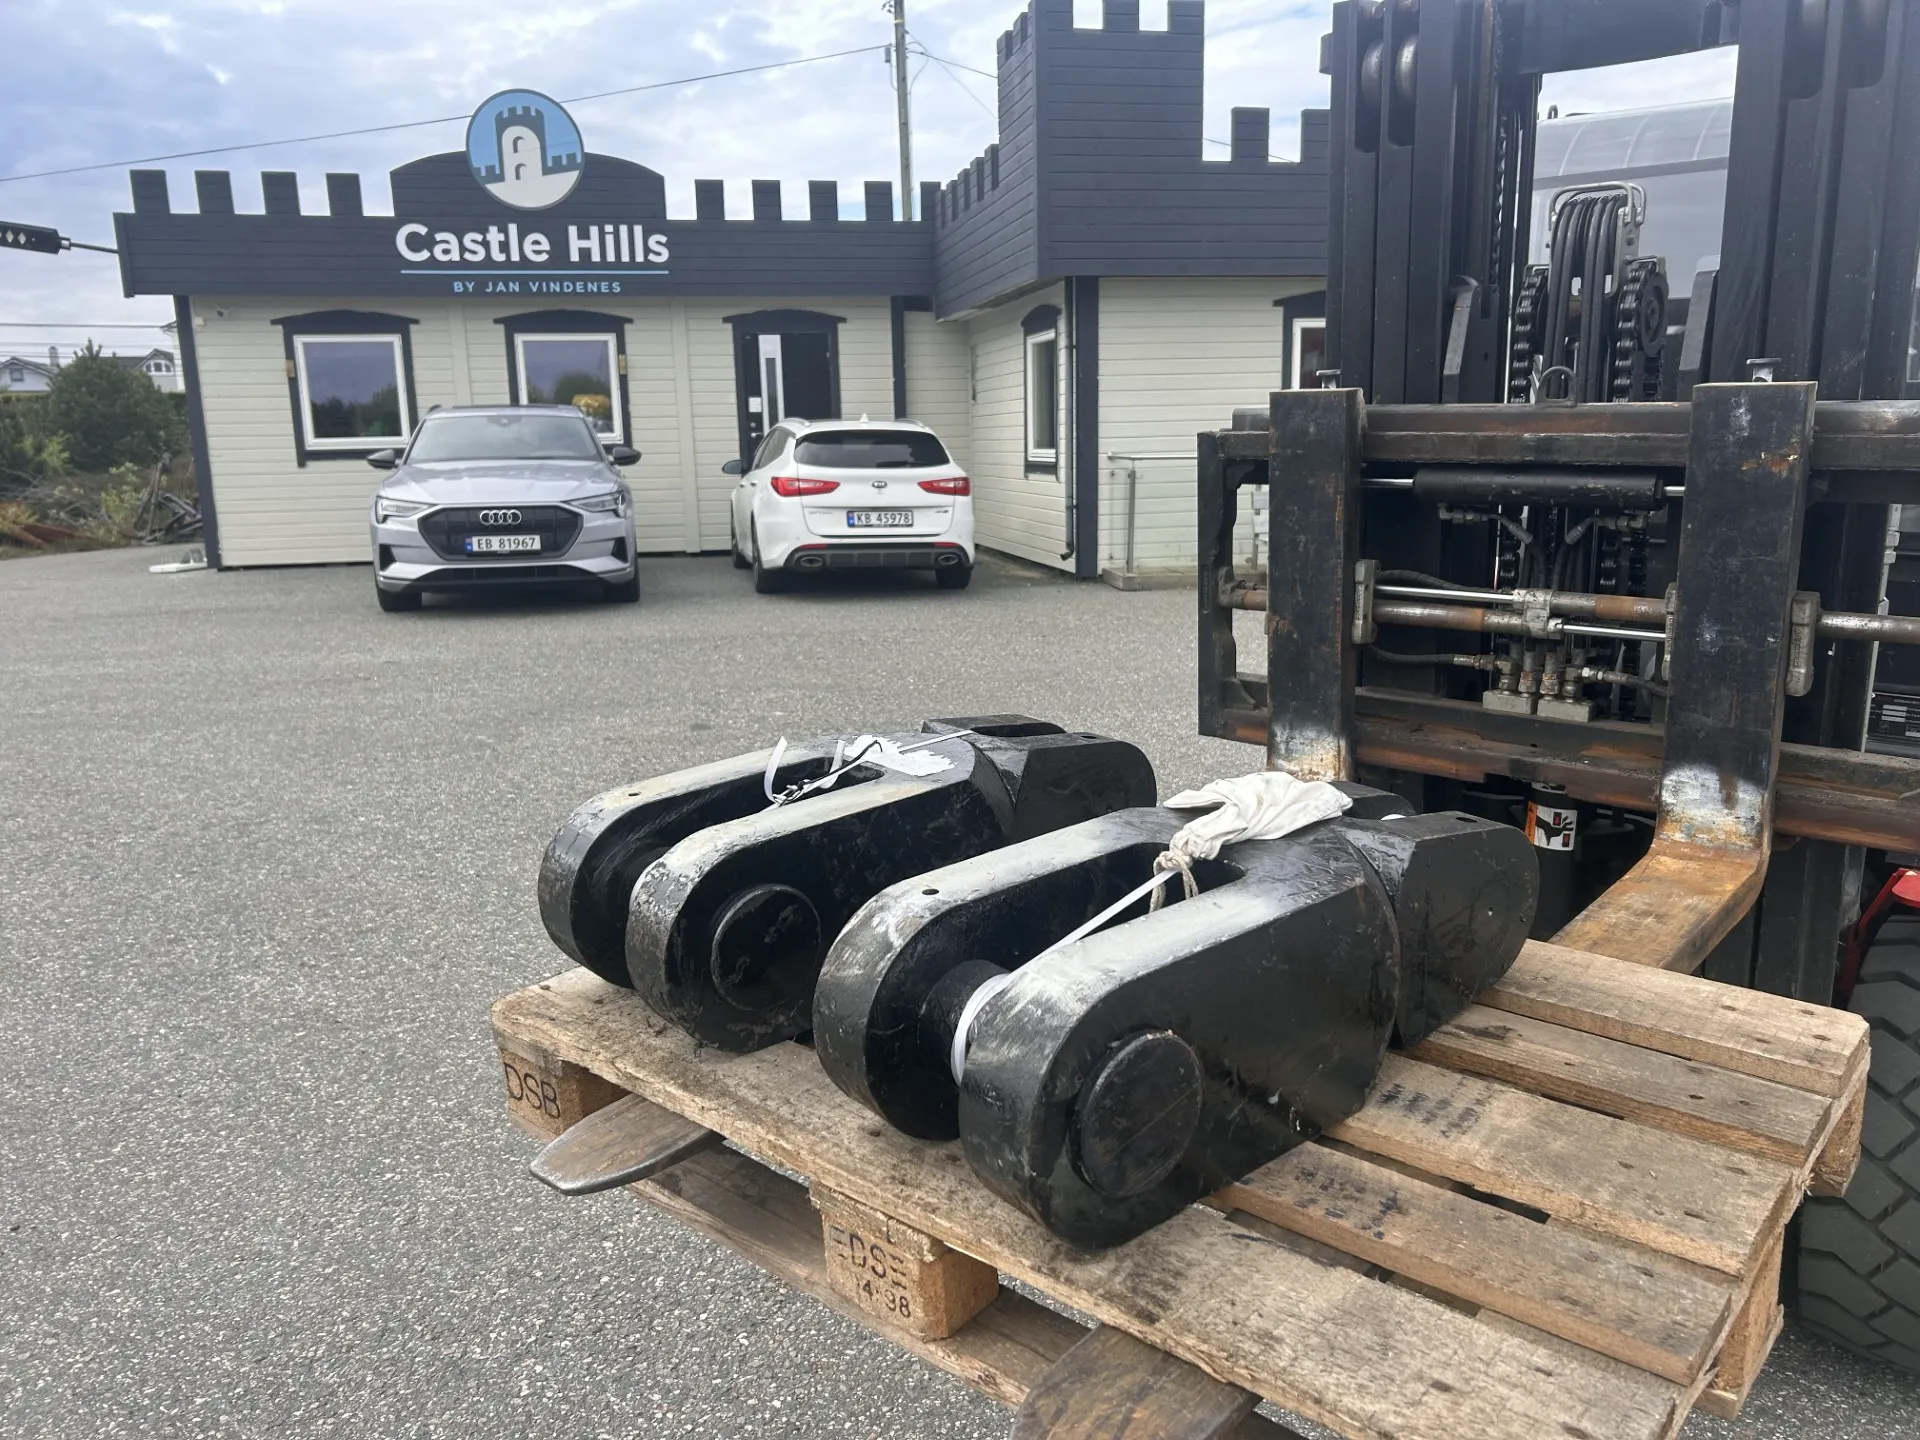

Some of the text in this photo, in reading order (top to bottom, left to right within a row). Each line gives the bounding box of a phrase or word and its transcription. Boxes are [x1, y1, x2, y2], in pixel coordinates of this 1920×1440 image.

[395, 223, 670, 263] Castle Hills
[453, 281, 622, 294] BY JAN VINDENES
[856, 513, 911, 524] KB 45978
[476, 537, 536, 550] EB 81967
[503, 1061, 561, 1120] DSB
